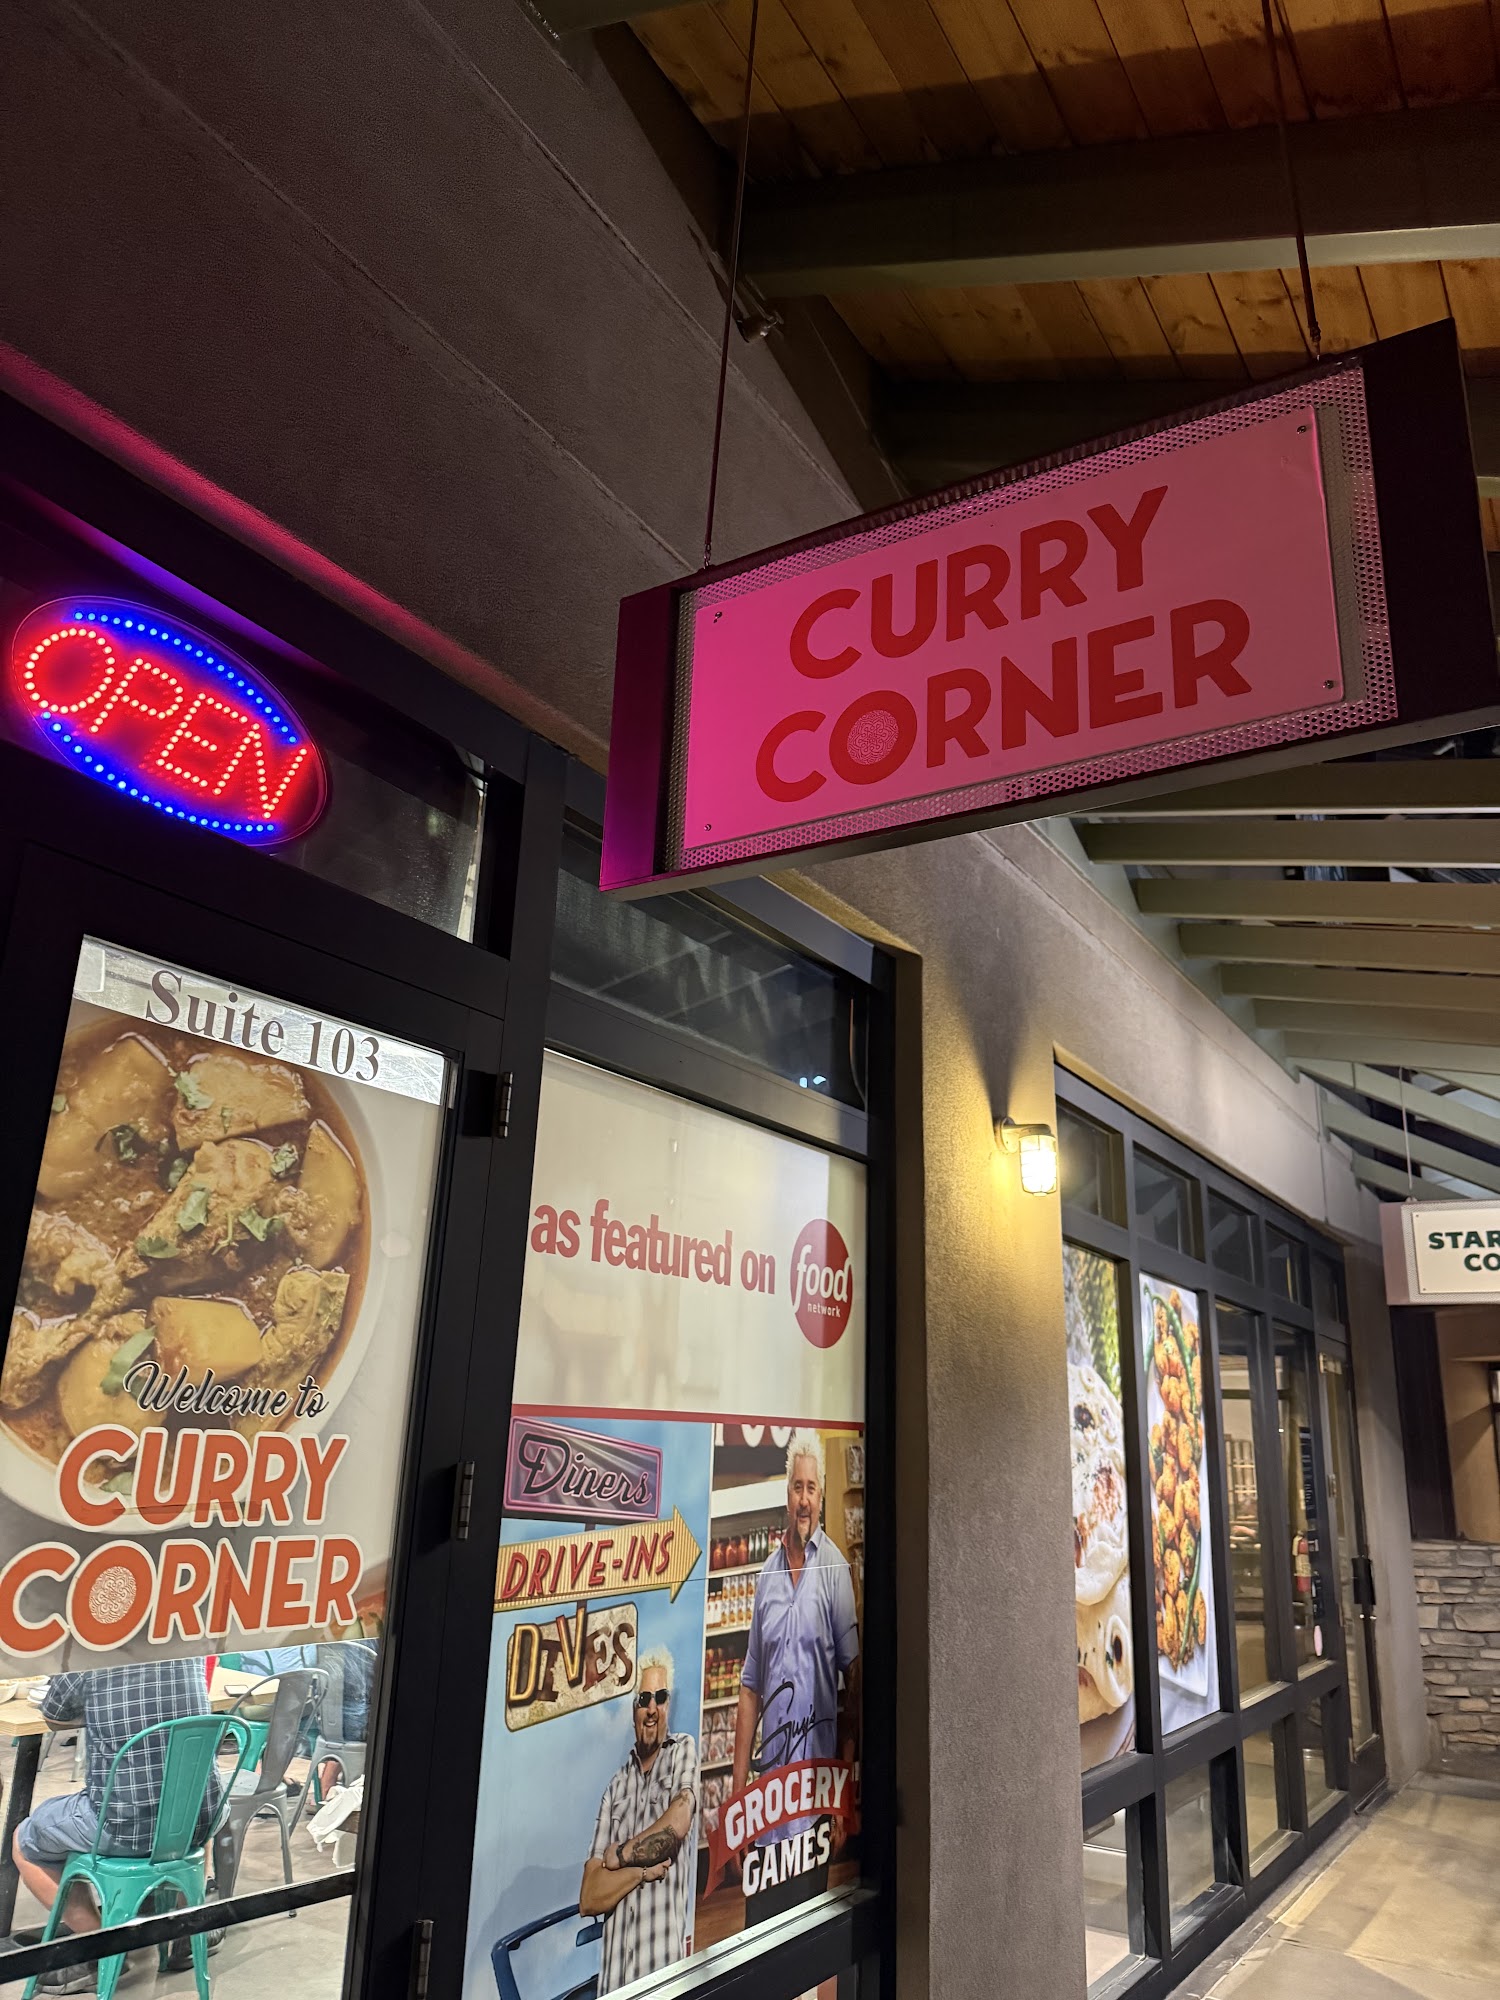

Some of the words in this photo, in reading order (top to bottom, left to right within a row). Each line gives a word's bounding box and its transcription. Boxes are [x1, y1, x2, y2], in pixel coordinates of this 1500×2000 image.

[789, 485, 1169, 679] CURRY
[24, 628, 308, 820] OPEN
[755, 599, 1252, 803] CORNER
[145, 969, 285, 1056] Suite
[305, 1019, 380, 1082] 103
[530, 1204, 581, 1258] as
[590, 1198, 733, 1286] featured
[740, 1250, 776, 1295] on
[793, 1244, 852, 1314] food
[807, 1302, 841, 1318] network
[123, 1360, 292, 1418] Welcome
[293, 1375, 330, 1418] to
[58, 1427, 348, 1526] CURRY
[516, 1431, 653, 1505] Diners
[0, 1536, 362, 1652] CORNER
[501, 1530, 674, 1599] DRIVE-INS
[724, 1766, 849, 1850] GROCERY
[742, 1821, 831, 1897] GAMES
